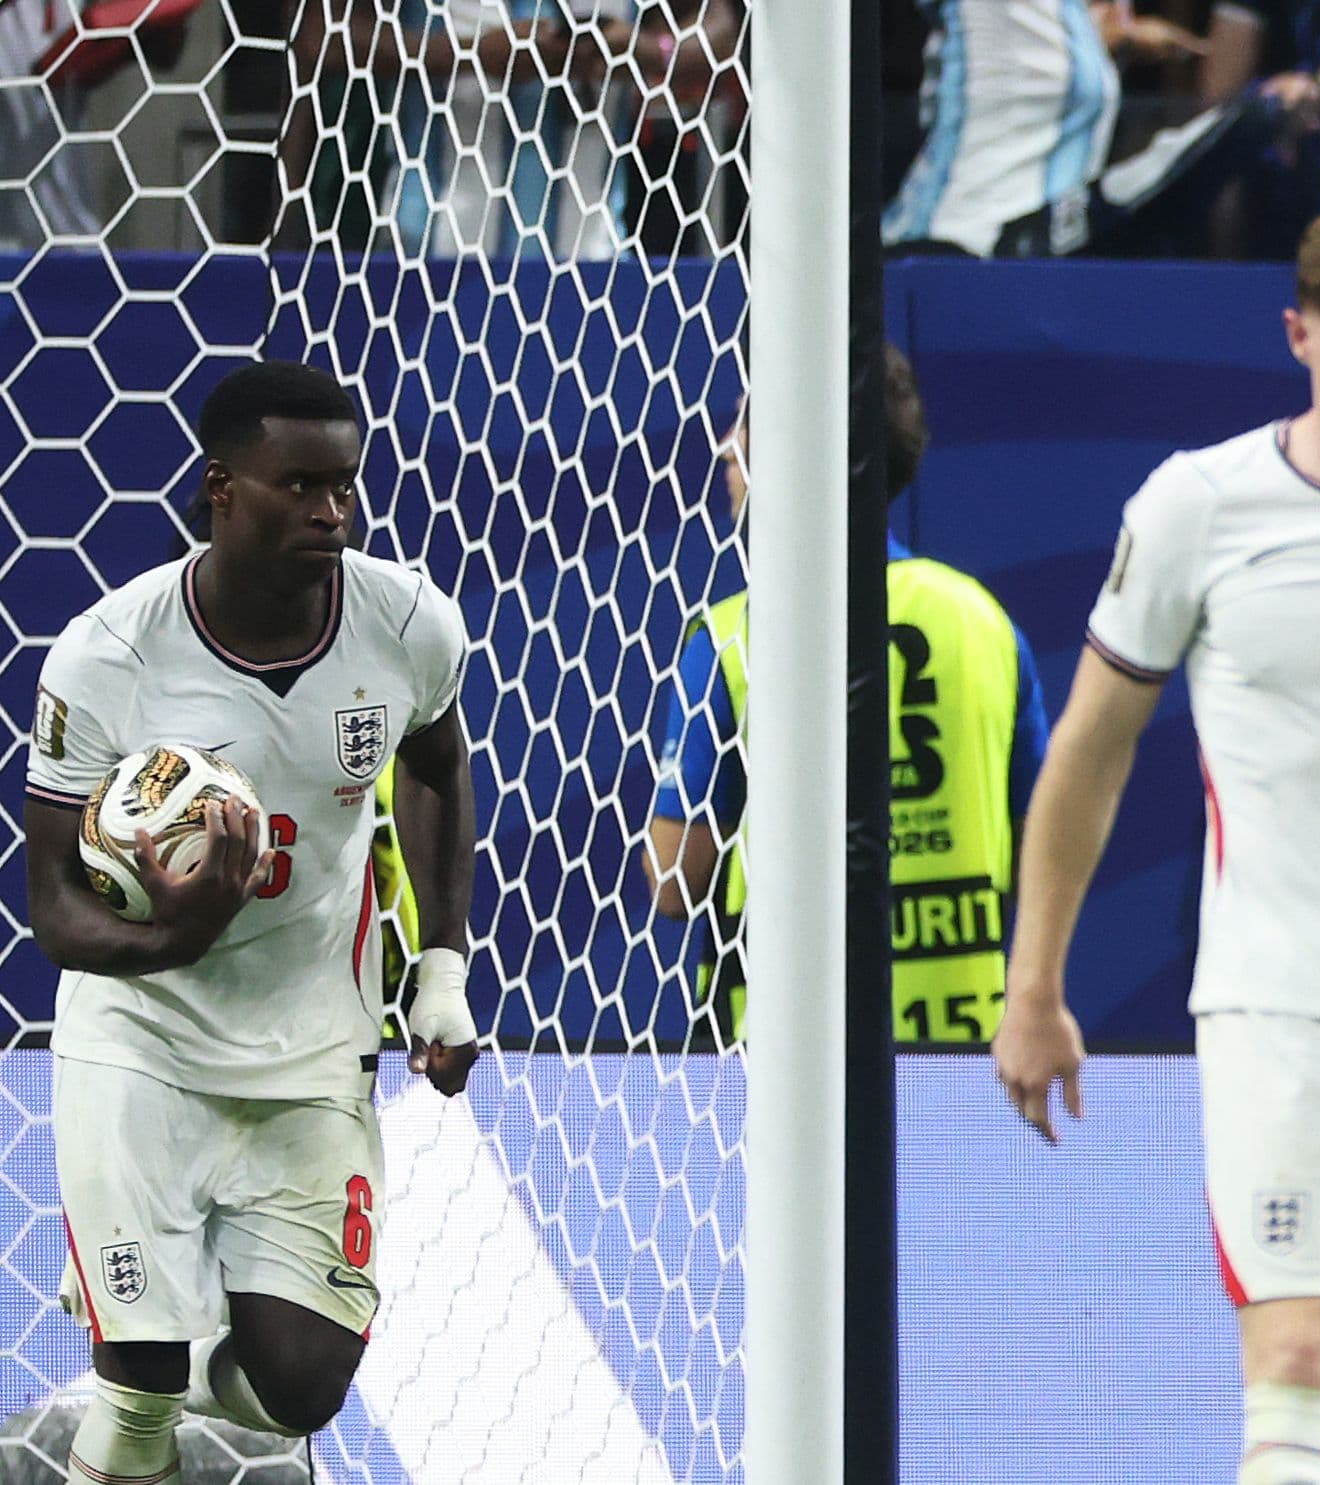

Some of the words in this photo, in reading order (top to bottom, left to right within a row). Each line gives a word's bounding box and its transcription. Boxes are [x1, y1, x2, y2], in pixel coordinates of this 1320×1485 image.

[256, 814, 297, 898] 6
[891, 889, 1001, 949] URIT
[903, 991, 1006, 1039] 15
[343, 1175, 373, 1268] 6
